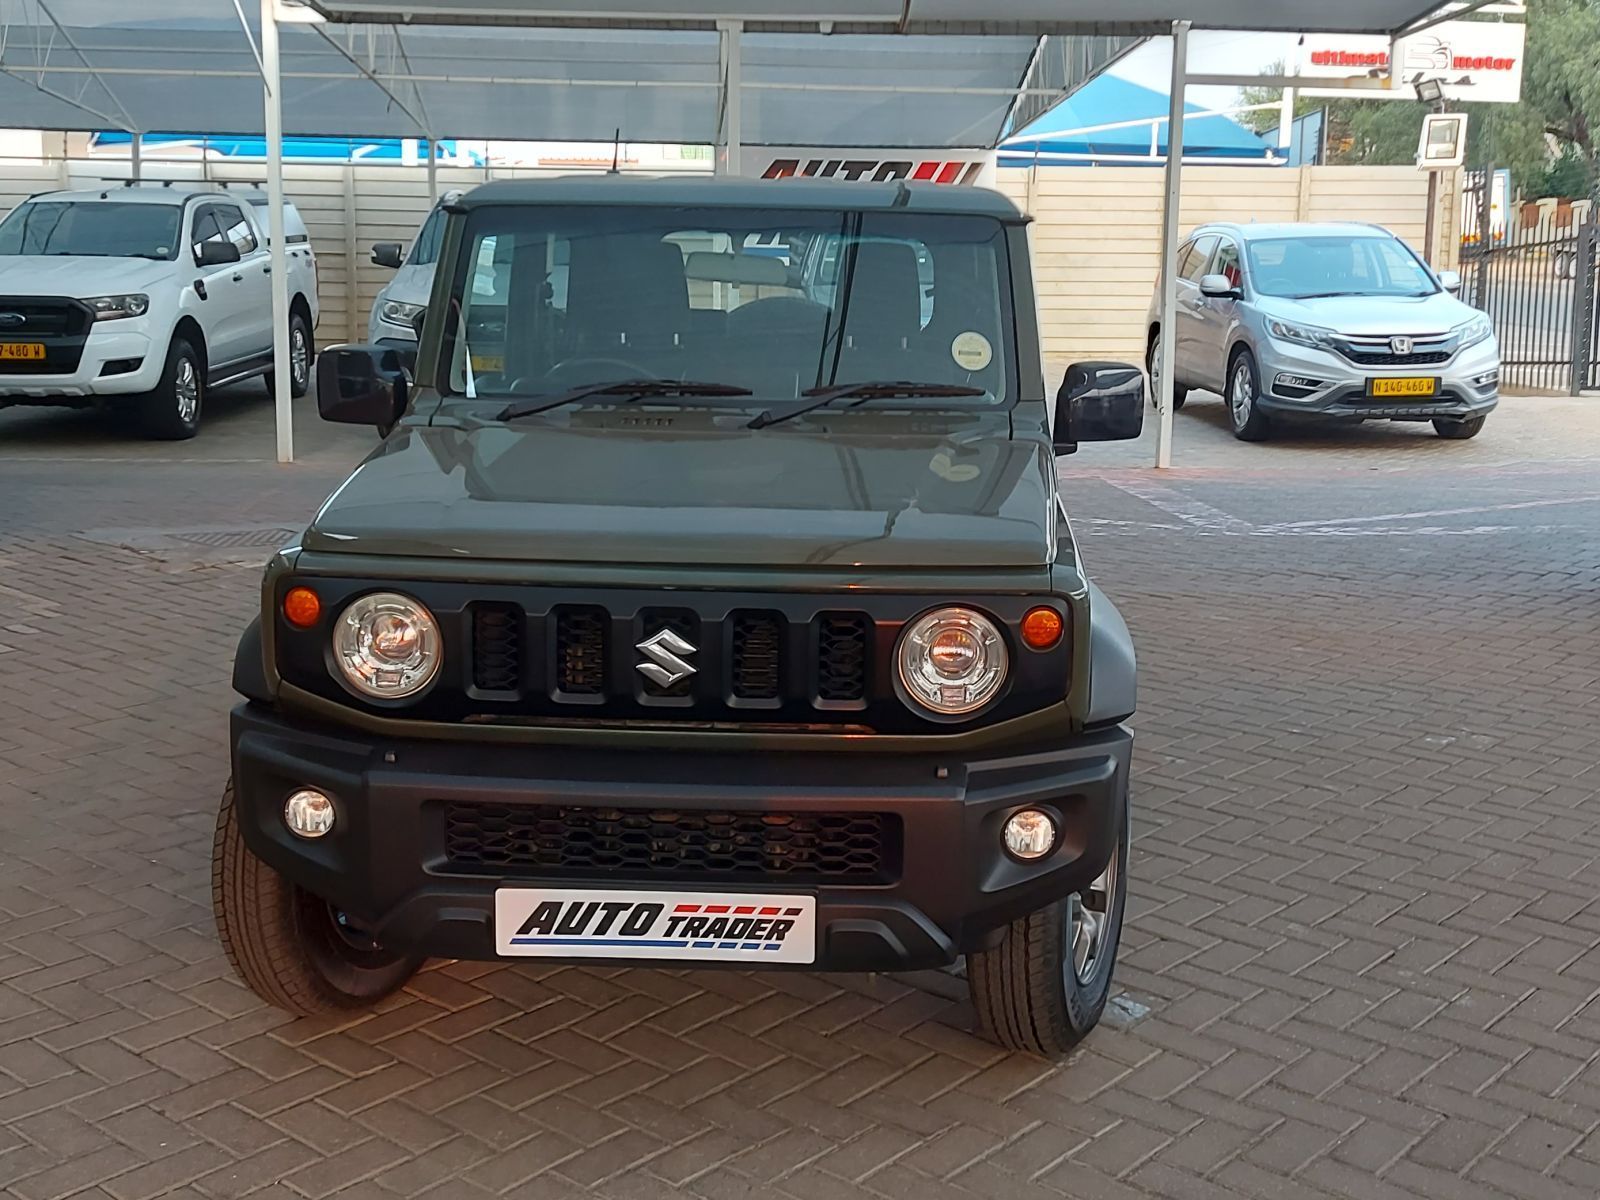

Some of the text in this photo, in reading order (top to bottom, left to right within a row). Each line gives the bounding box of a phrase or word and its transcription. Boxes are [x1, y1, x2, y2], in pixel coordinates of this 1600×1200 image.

[1311, 50, 1516, 70] ultimat motor
[1375, 381, 1382, 393] N
[515, 901, 795, 941] AUTO TRADER
